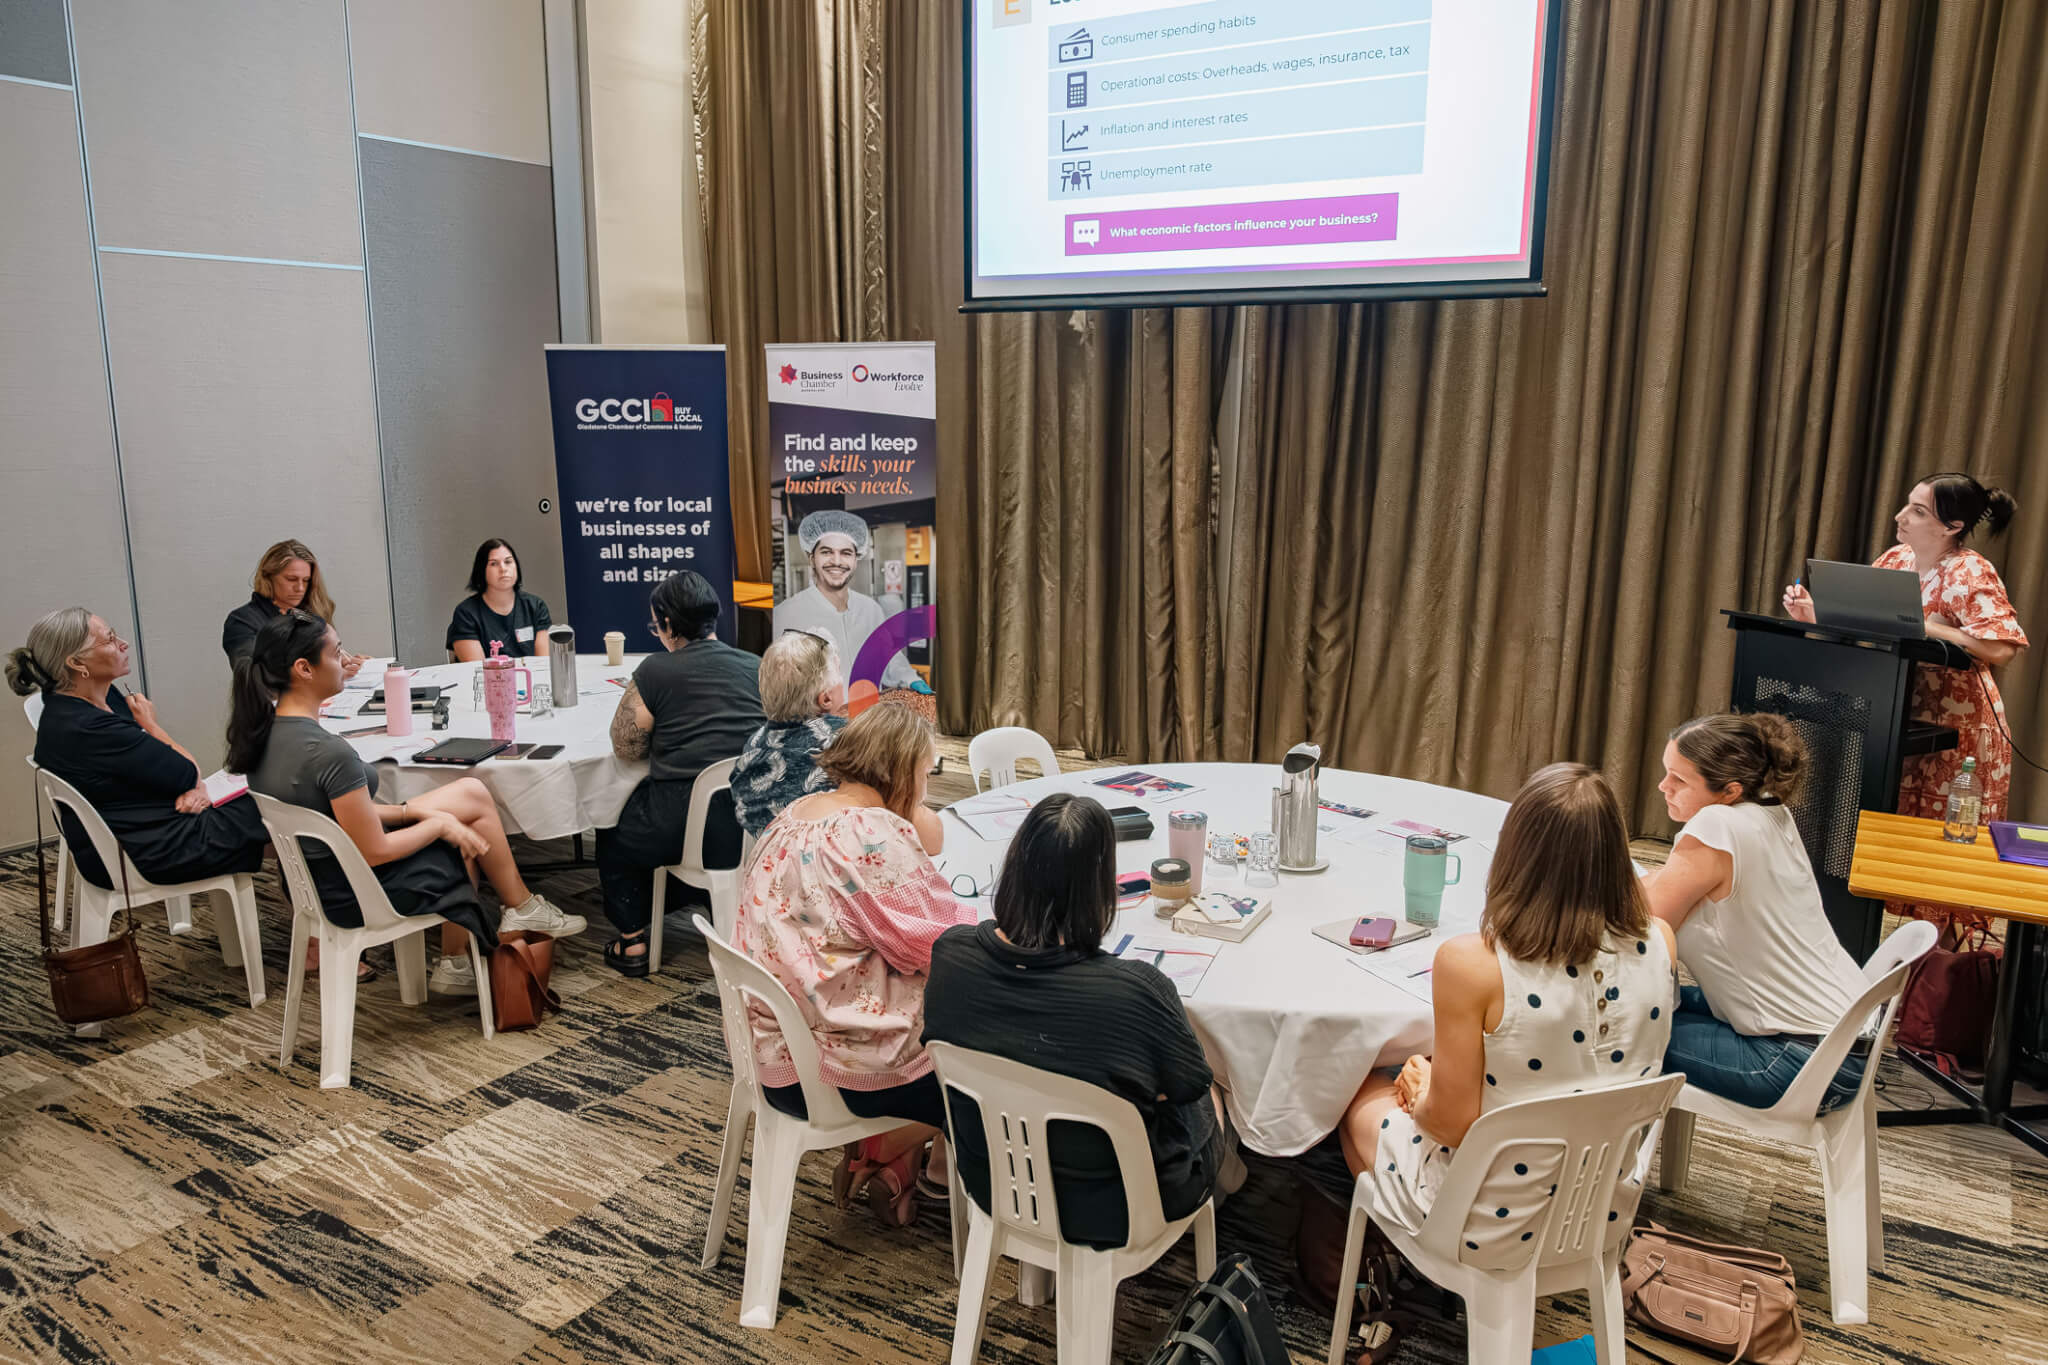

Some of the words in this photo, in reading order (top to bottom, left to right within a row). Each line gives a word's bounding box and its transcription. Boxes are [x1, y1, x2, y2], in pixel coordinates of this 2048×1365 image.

[1101, 29, 1158, 46] Consumer
[1161, 20, 1216, 41] spending
[1218, 14, 1257, 31] habits
[1101, 70, 1165, 93] Operational
[1168, 71, 1200, 84] costs:
[1202, 61, 1270, 80] Overheads,
[1272, 56, 1316, 72] wages,
[1318, 49, 1387, 66] insurance,
[1389, 44, 1411, 57] tax
[1100, 123, 1145, 136] Inflation
[1147, 119, 1169, 132] and
[1171, 115, 1216, 129] interest
[1218, 111, 1249, 124] rates
[1100, 163, 1187, 181] Unemployment
[1189, 160, 1214, 174] rate
[1109, 226, 1138, 238] What
[1140, 223, 1191, 236] economic
[1194, 221, 1232, 234] factors
[1234, 217, 1287, 231] influence
[1289, 218, 1317, 231] your
[1319, 213, 1379, 227] business?
[801, 371, 844, 380] Business
[870, 372, 925, 382] Workforce
[894, 382, 924, 391] Evolve
[575, 398, 651, 422] GCCI
[674, 407, 691, 415] BUY
[674, 414, 703, 422] LOCAL
[784, 433, 825, 451] Find
[830, 433, 866, 451] and
[871, 433, 918, 454] keep
[784, 455, 816, 472] the
[819, 454, 867, 473] skills
[869, 457, 916, 478] your
[784, 475, 857, 495] business
[860, 476, 913, 495] needs.
[575, 498, 630, 513] we're
[634, 497, 663, 513] for
[667, 496, 712, 513] local
[580, 520, 687, 537] businesses
[690, 520, 711, 536] of
[600, 543, 624, 559] all
[628, 543, 695, 563] shapes
[602, 566, 639, 582] and
[643, 566, 679, 582] siz
